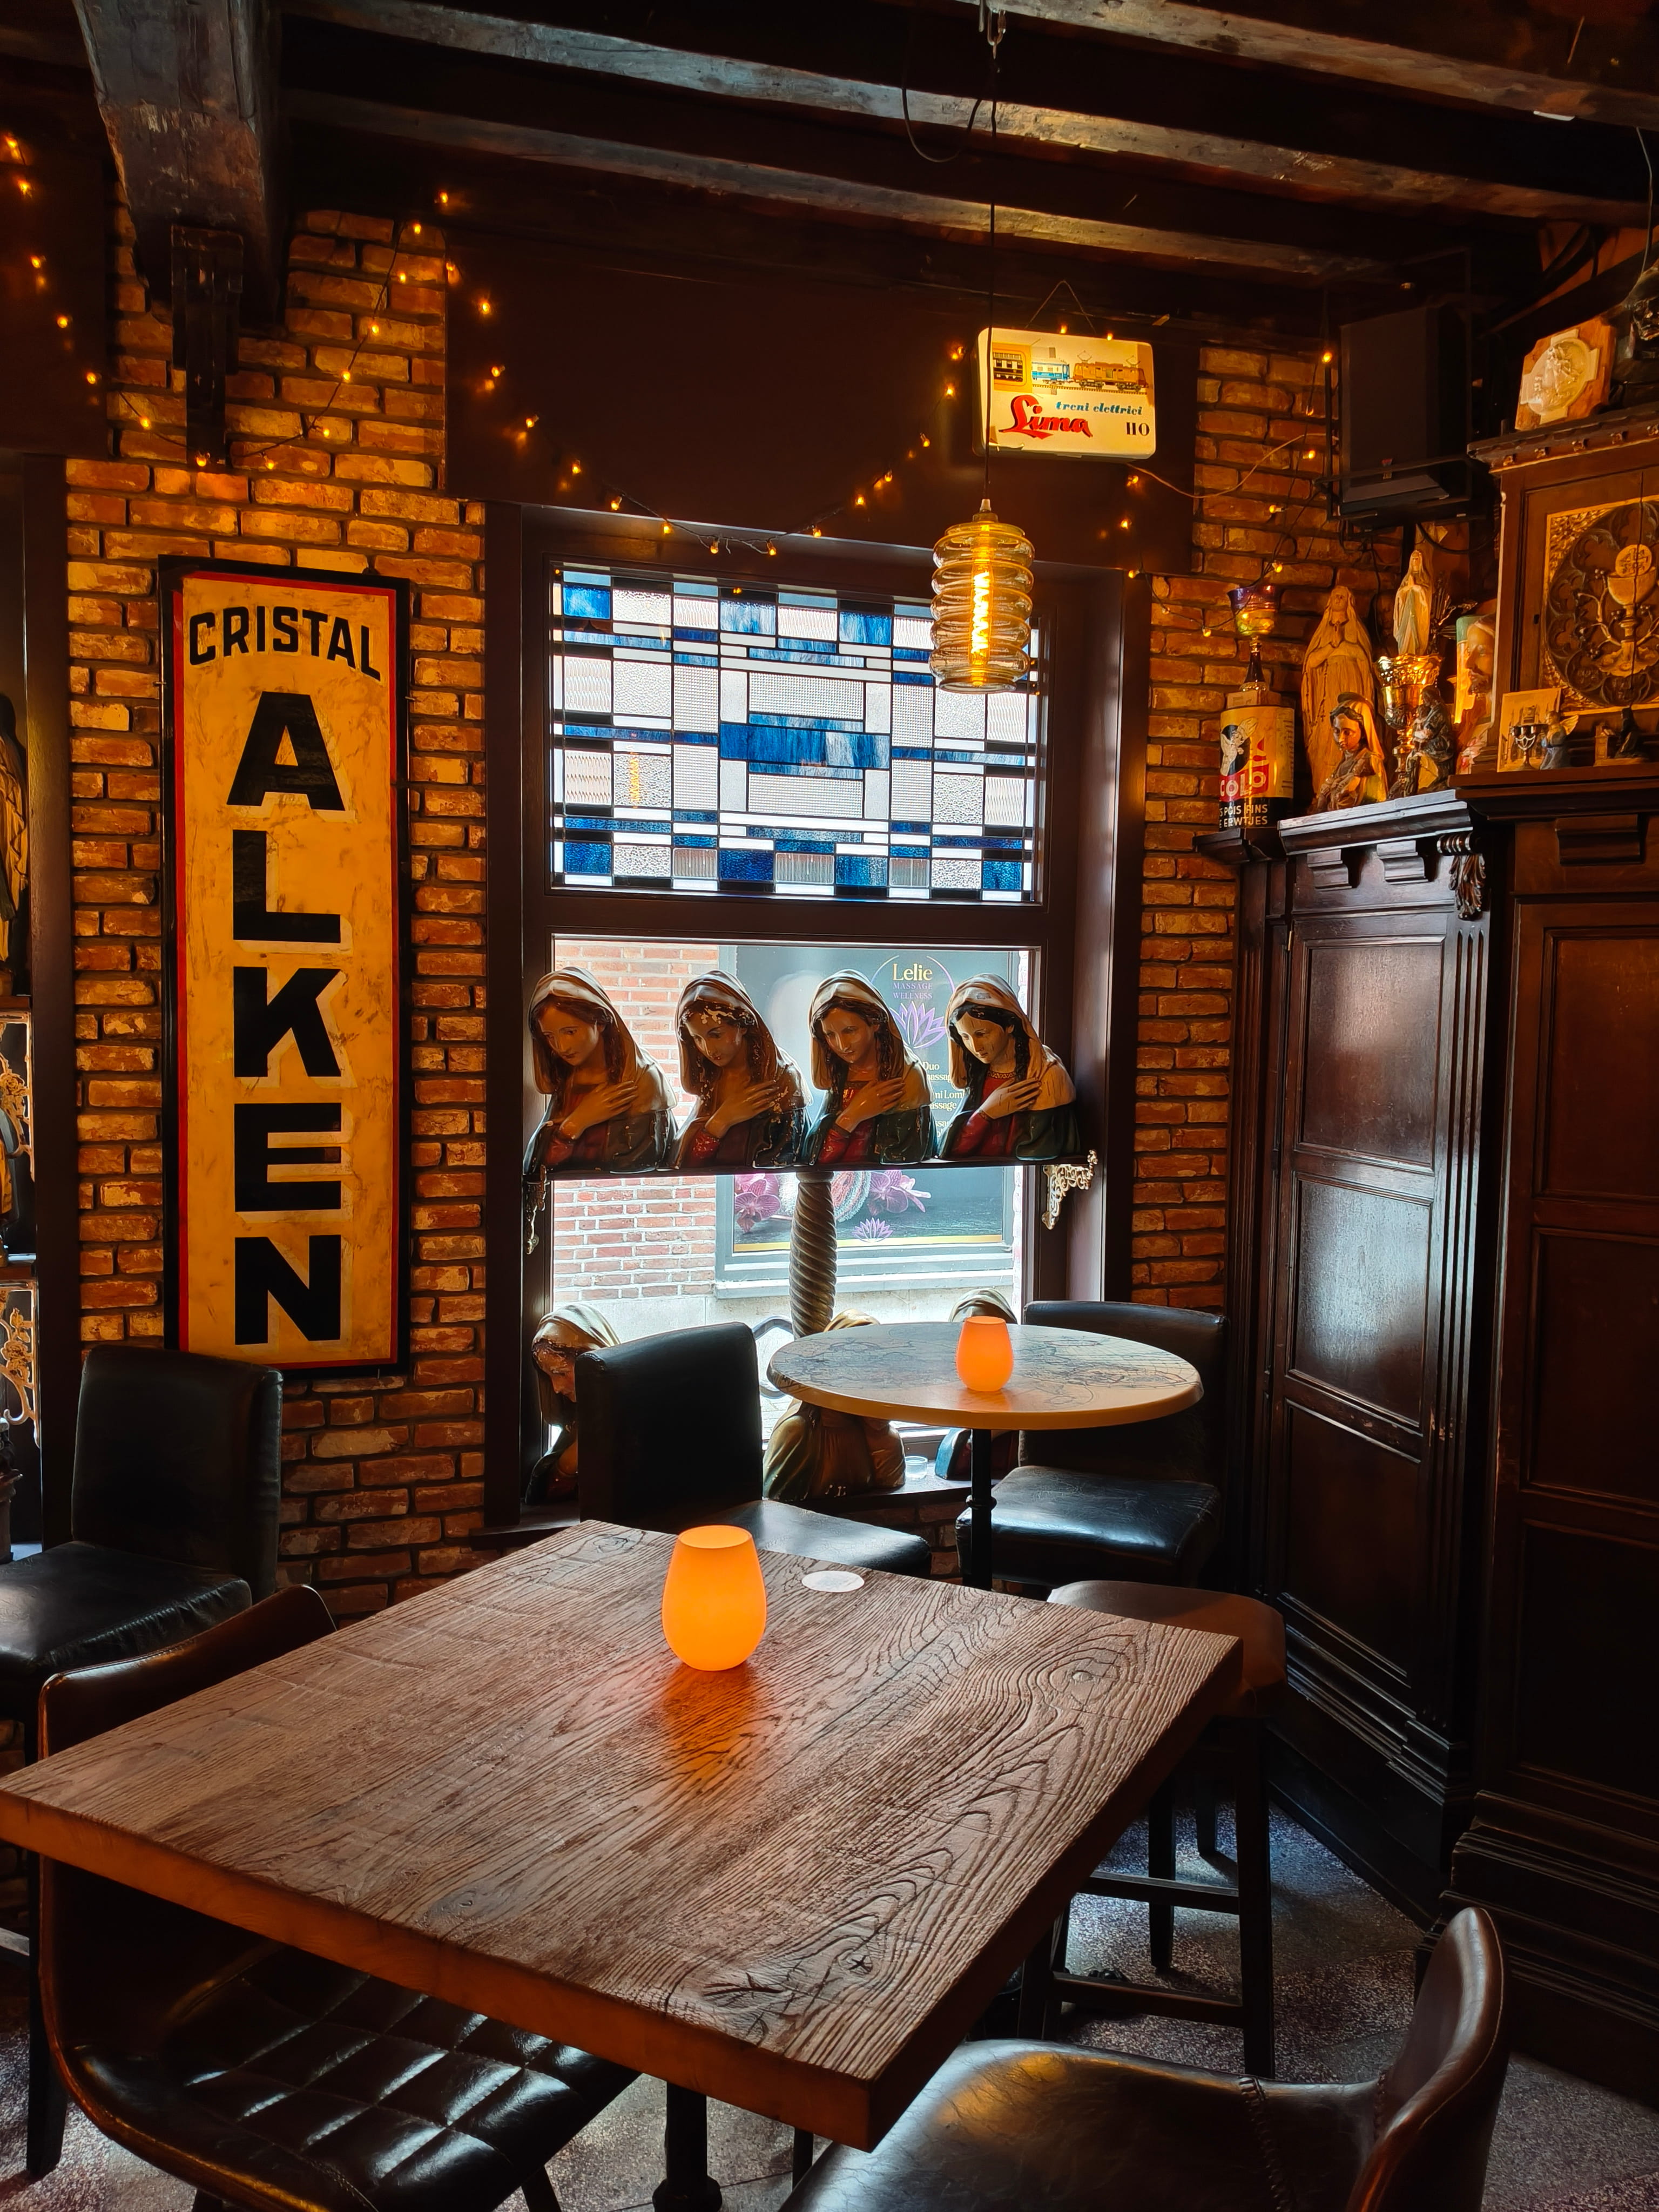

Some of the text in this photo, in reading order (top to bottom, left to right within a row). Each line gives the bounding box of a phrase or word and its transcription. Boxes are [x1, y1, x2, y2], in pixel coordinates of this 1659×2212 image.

[1056, 401, 1142, 415] treni elettrici
[999, 395, 1092, 439] Lima
[190, 605, 381, 682] CRISTAL
[1224, 805, 1242, 815] POIS
[1224, 816, 1268, 827] ERWTJES
[893, 963, 933, 981] Lelie
[226, 691, 346, 1346] ALKEN
[922, 1061, 940, 1070] Duo
[930, 1102, 957, 1111] assage
